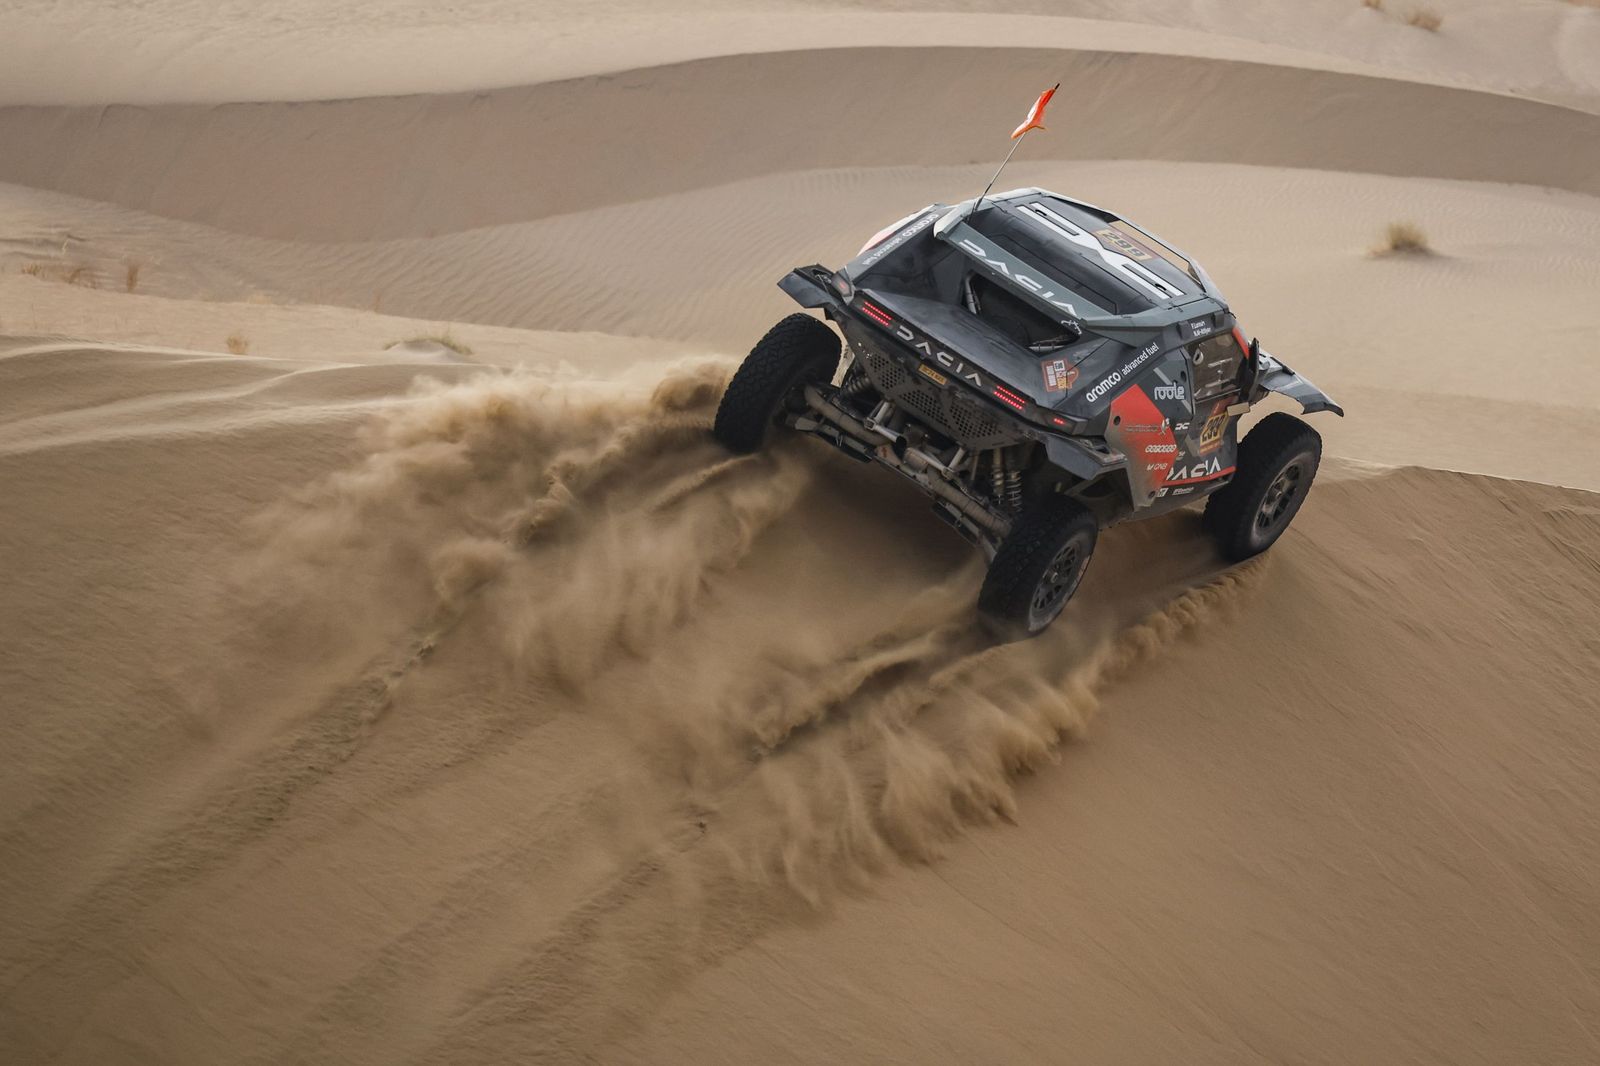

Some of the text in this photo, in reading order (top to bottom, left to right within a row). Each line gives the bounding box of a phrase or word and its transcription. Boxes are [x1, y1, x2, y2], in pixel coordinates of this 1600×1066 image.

[1102, 232, 1146, 257] 299
[958, 239, 1077, 317] DACIA
[897, 325, 982, 387] DACIA
[1086, 371, 1122, 403] aramco
[1122, 350, 1149, 376] advanced
[1146, 341, 1160, 359] fuel
